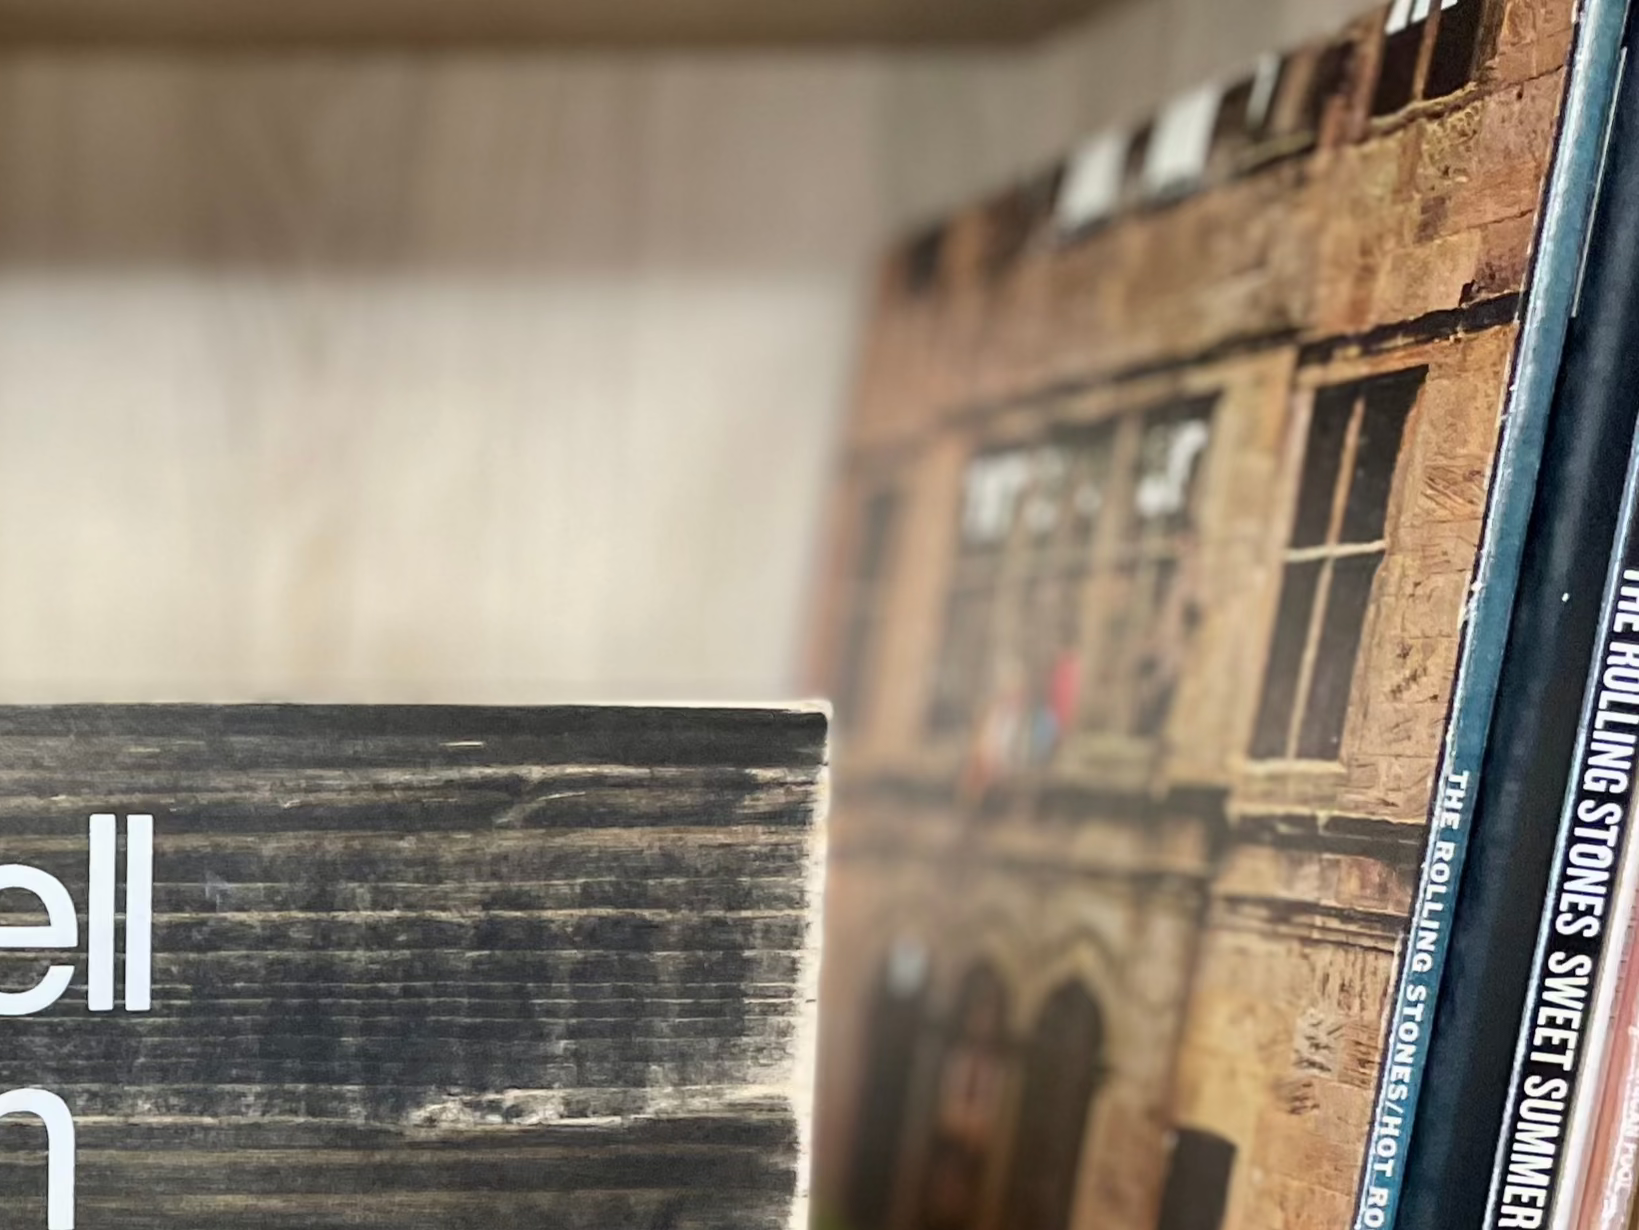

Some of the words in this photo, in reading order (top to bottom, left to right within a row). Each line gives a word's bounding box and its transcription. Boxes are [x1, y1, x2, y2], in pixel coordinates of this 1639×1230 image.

[1581, 640, 1634, 795] ROLLING
[1439, 768, 1470, 829] THE
[1410, 839, 1457, 974] ROLLING
[1553, 798, 1619, 940] STONES
[1528, 948, 1590, 1070] SWEET
[1372, 985, 1424, 1175] STONES/HOT
